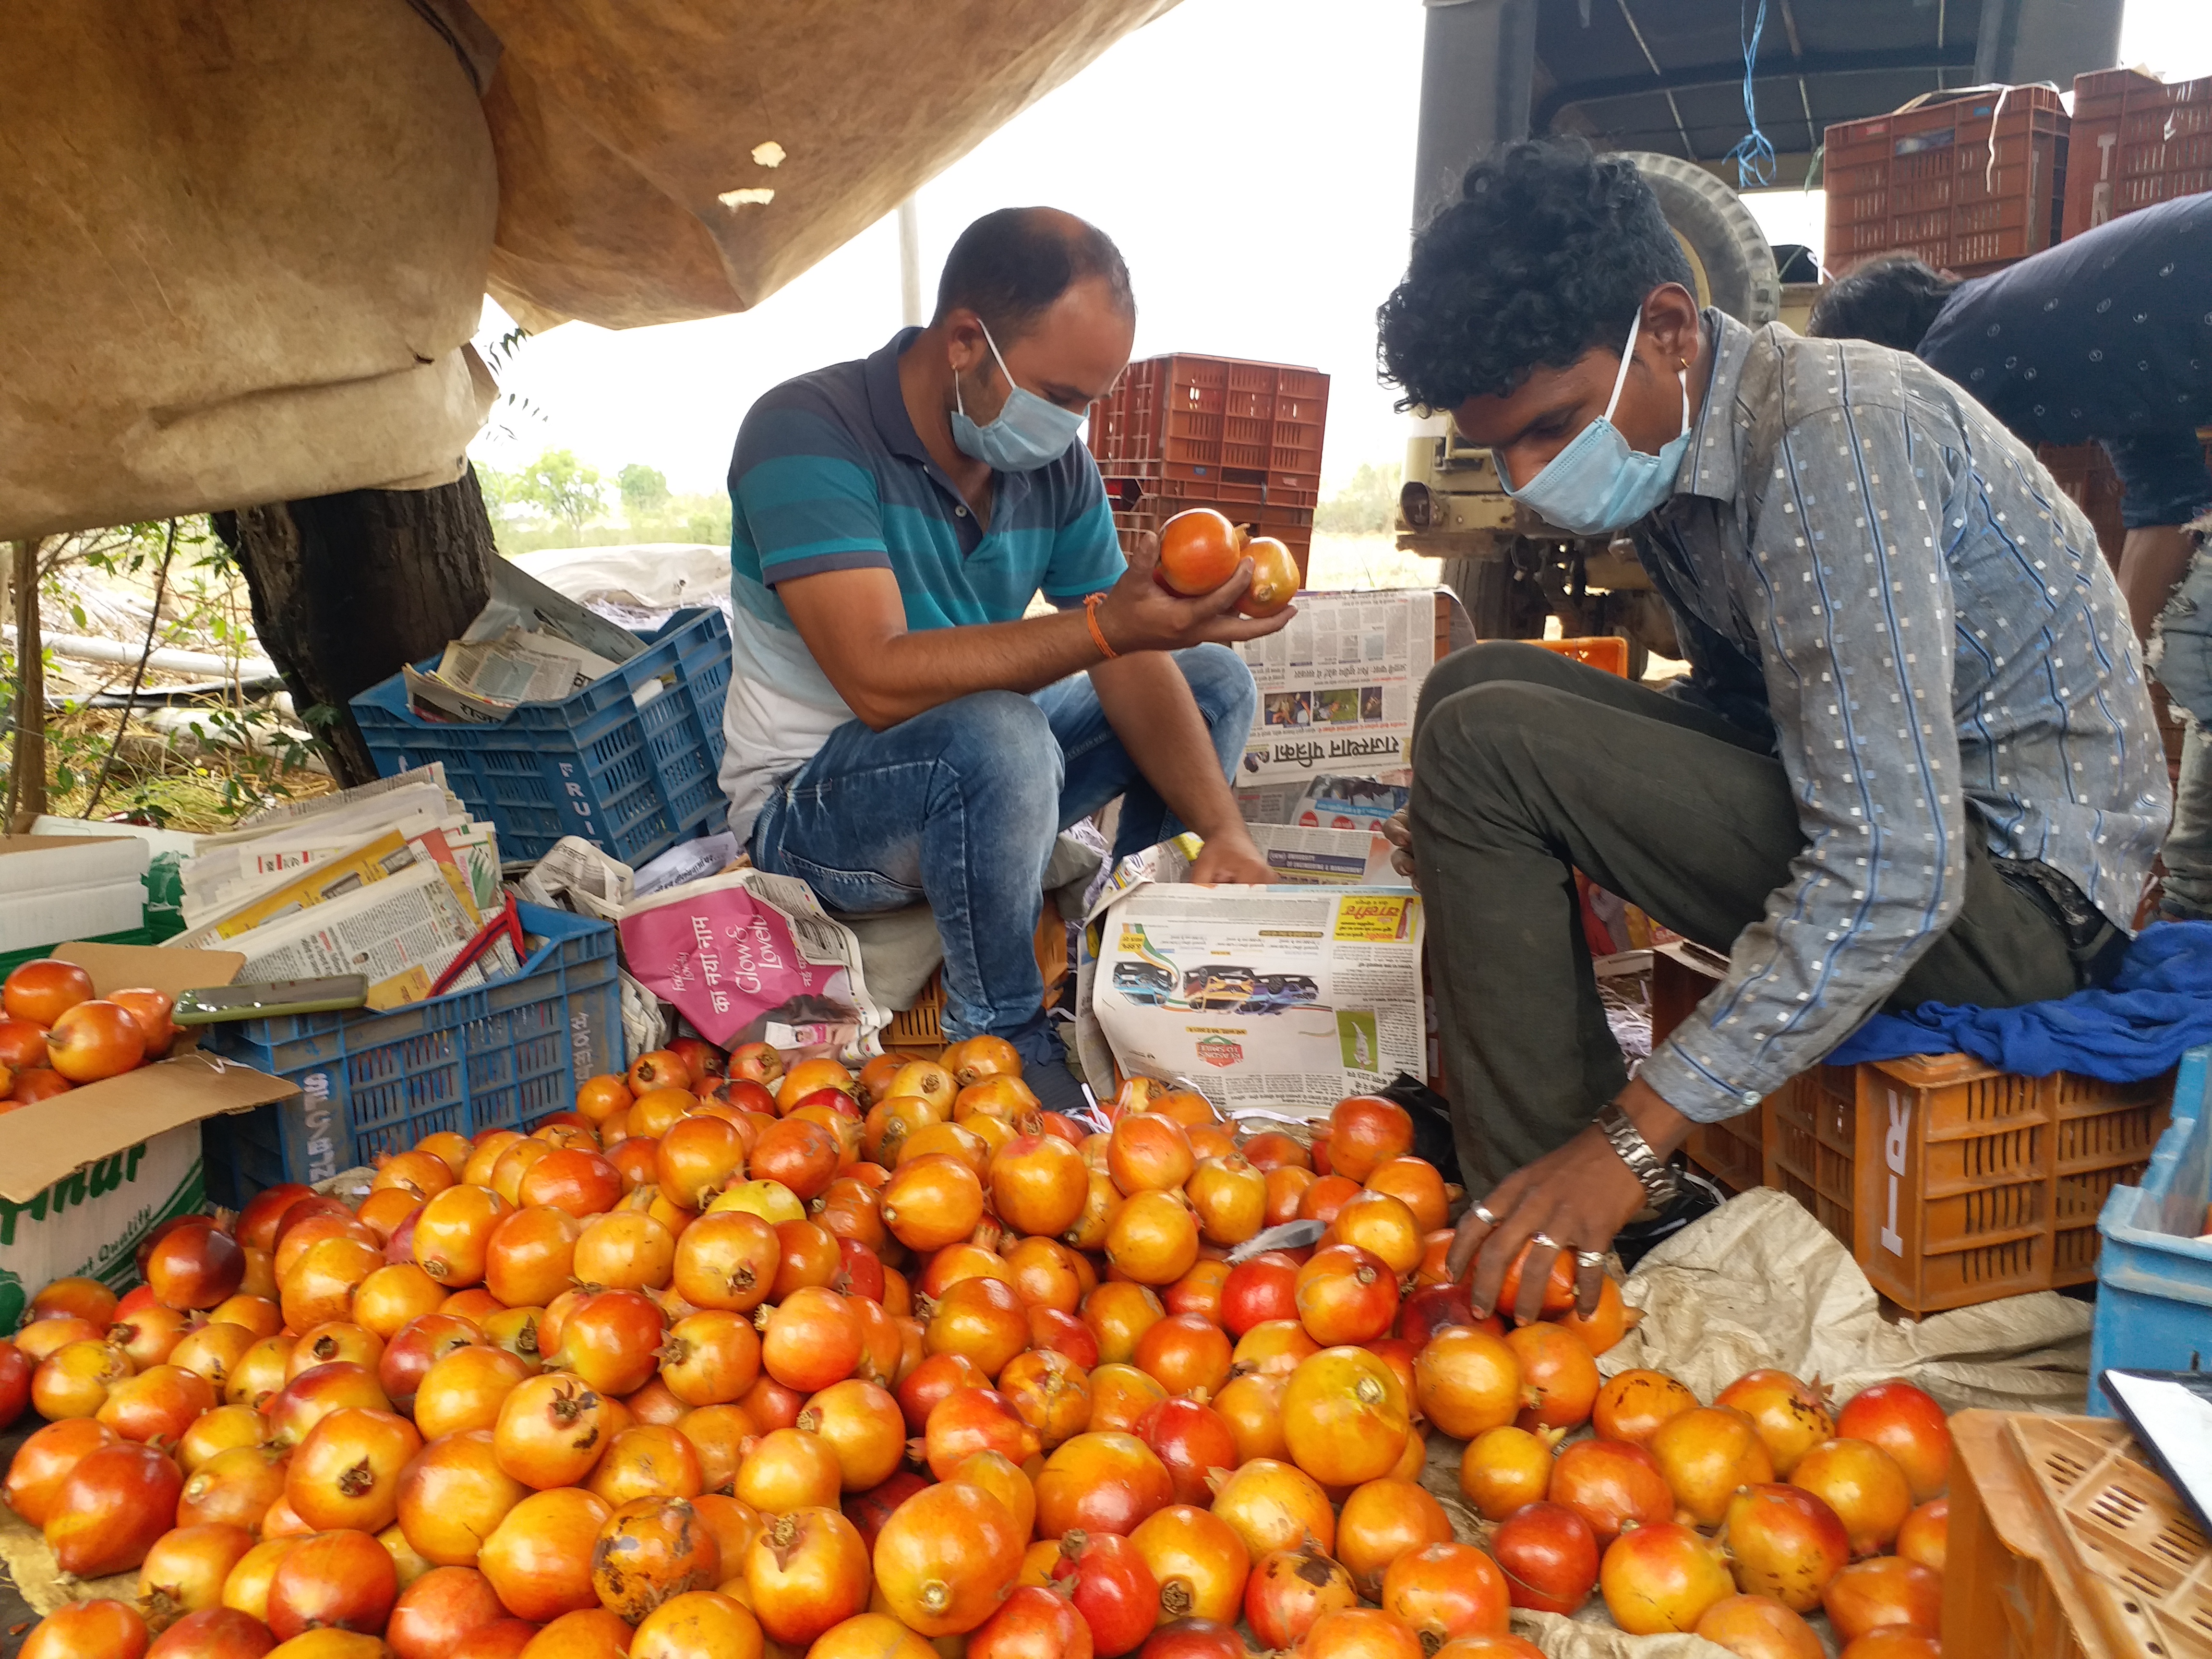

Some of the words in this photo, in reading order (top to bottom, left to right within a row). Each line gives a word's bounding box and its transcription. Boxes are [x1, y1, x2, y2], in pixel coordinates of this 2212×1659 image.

[1273, 741, 1324, 768] पत्रिका
[1328, 736, 1400, 758] राजस्थान
[691, 915, 714, 950] नाम
[676, 951, 696, 982] Lovely
[699, 953, 722, 986] नया
[733, 942, 762, 994] Glow
[709, 989, 731, 1015] का
[97, 1203, 153, 1263] Quality
